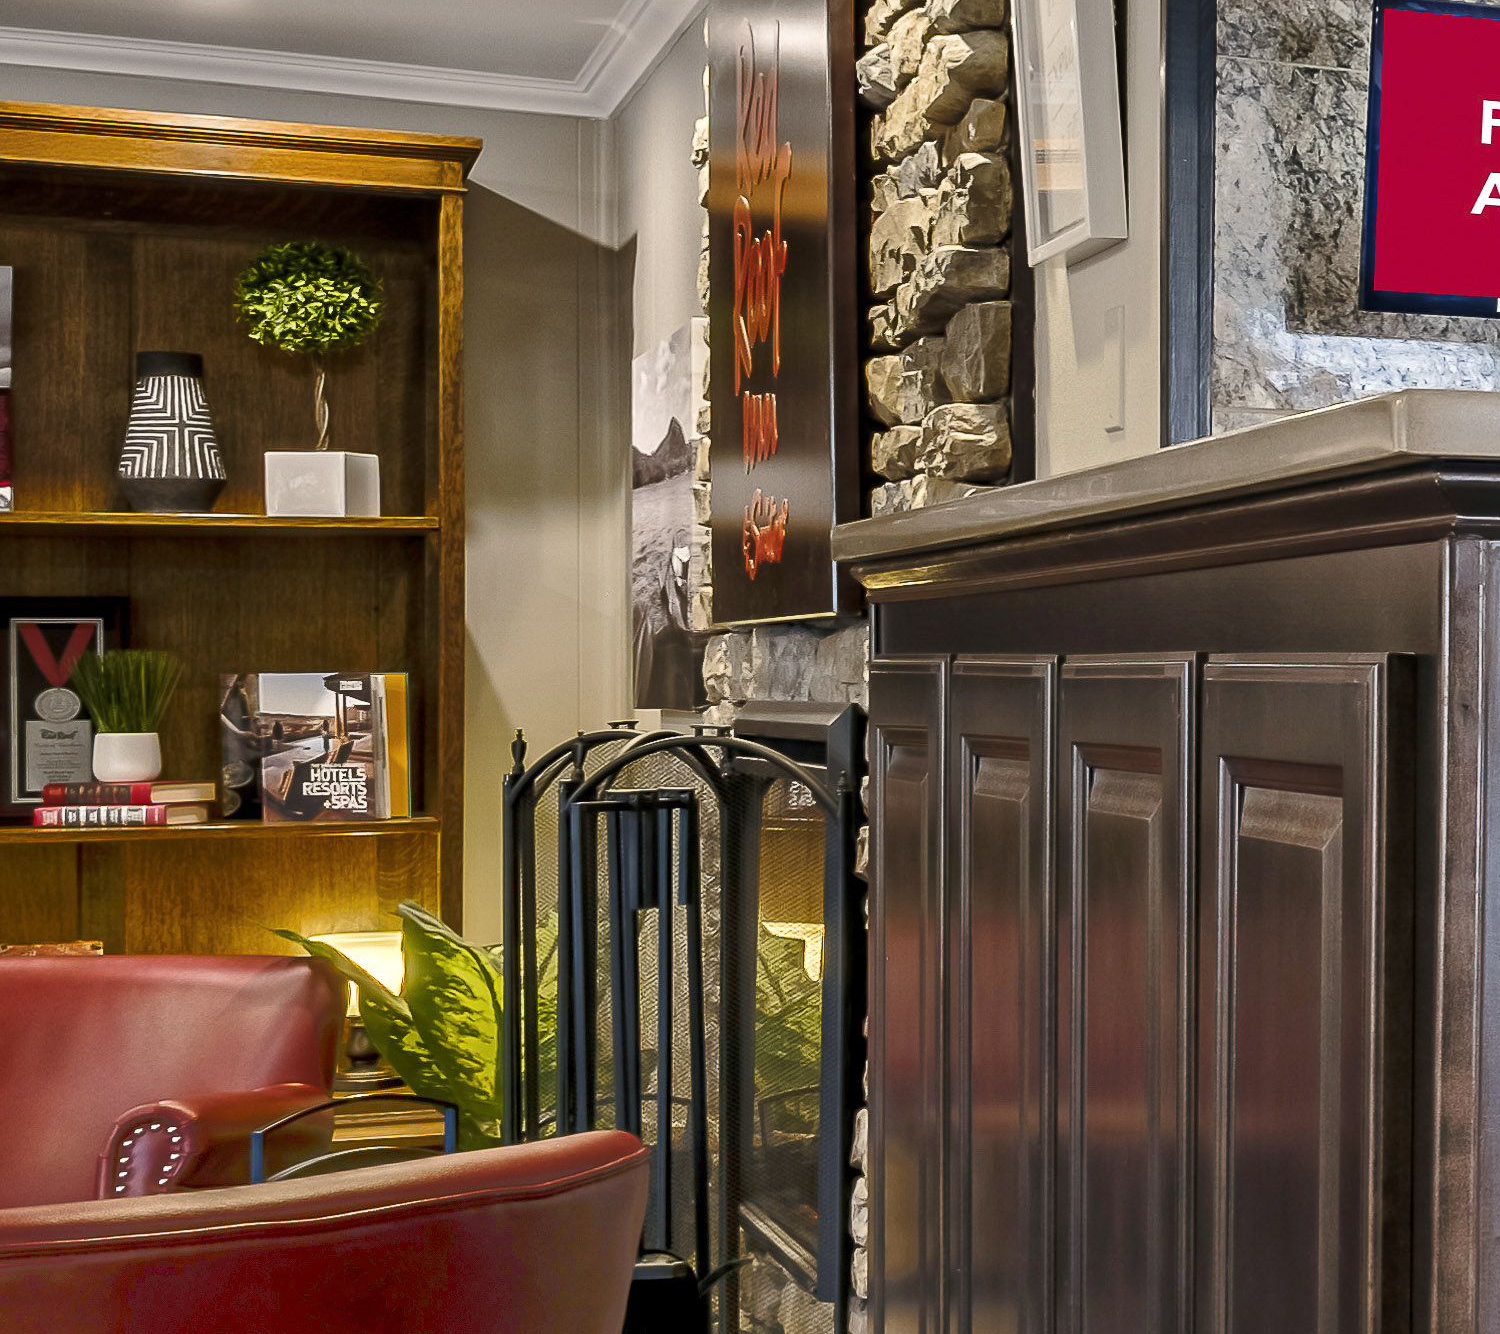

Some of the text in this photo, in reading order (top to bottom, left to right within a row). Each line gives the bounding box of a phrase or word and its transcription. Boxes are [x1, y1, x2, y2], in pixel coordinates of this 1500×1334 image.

[736, 19, 780, 196] Red
[733, 141, 793, 398] Roof
[310, 768, 367, 782] HOTELS
[302, 781, 368, 796] RESORTS
[323, 795, 368, 810] +SPAS
